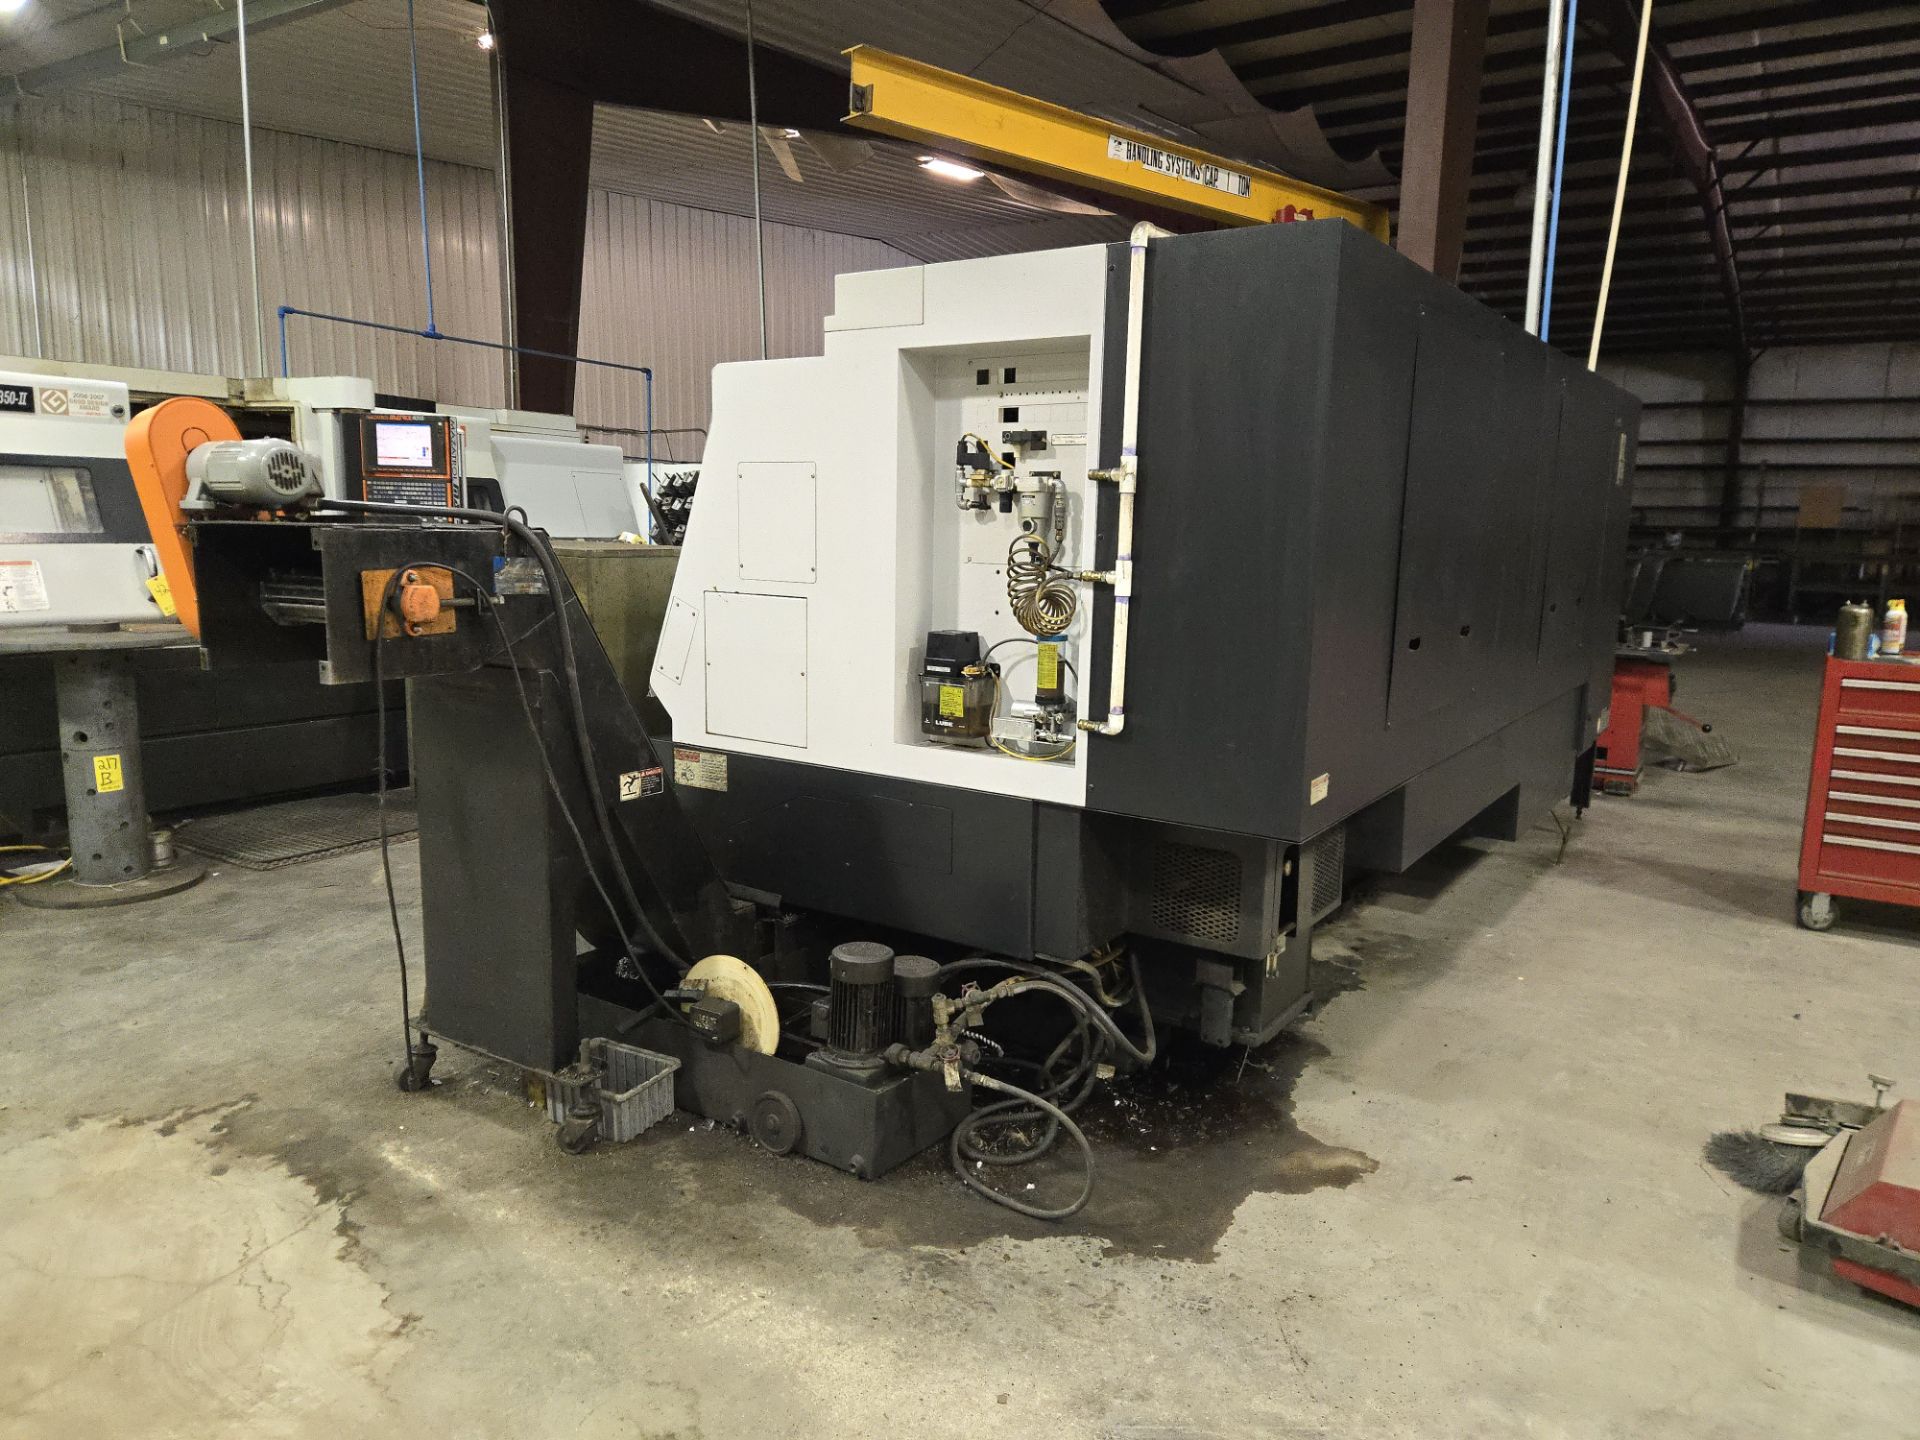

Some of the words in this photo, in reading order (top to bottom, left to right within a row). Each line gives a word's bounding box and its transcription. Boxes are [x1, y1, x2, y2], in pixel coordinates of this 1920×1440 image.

[1126, 141, 1163, 169] HANDLING
[1165, 153, 1201, 181] SYSTEMS
[1238, 174, 1251, 197] TON
[100, 771, 112, 787] B
